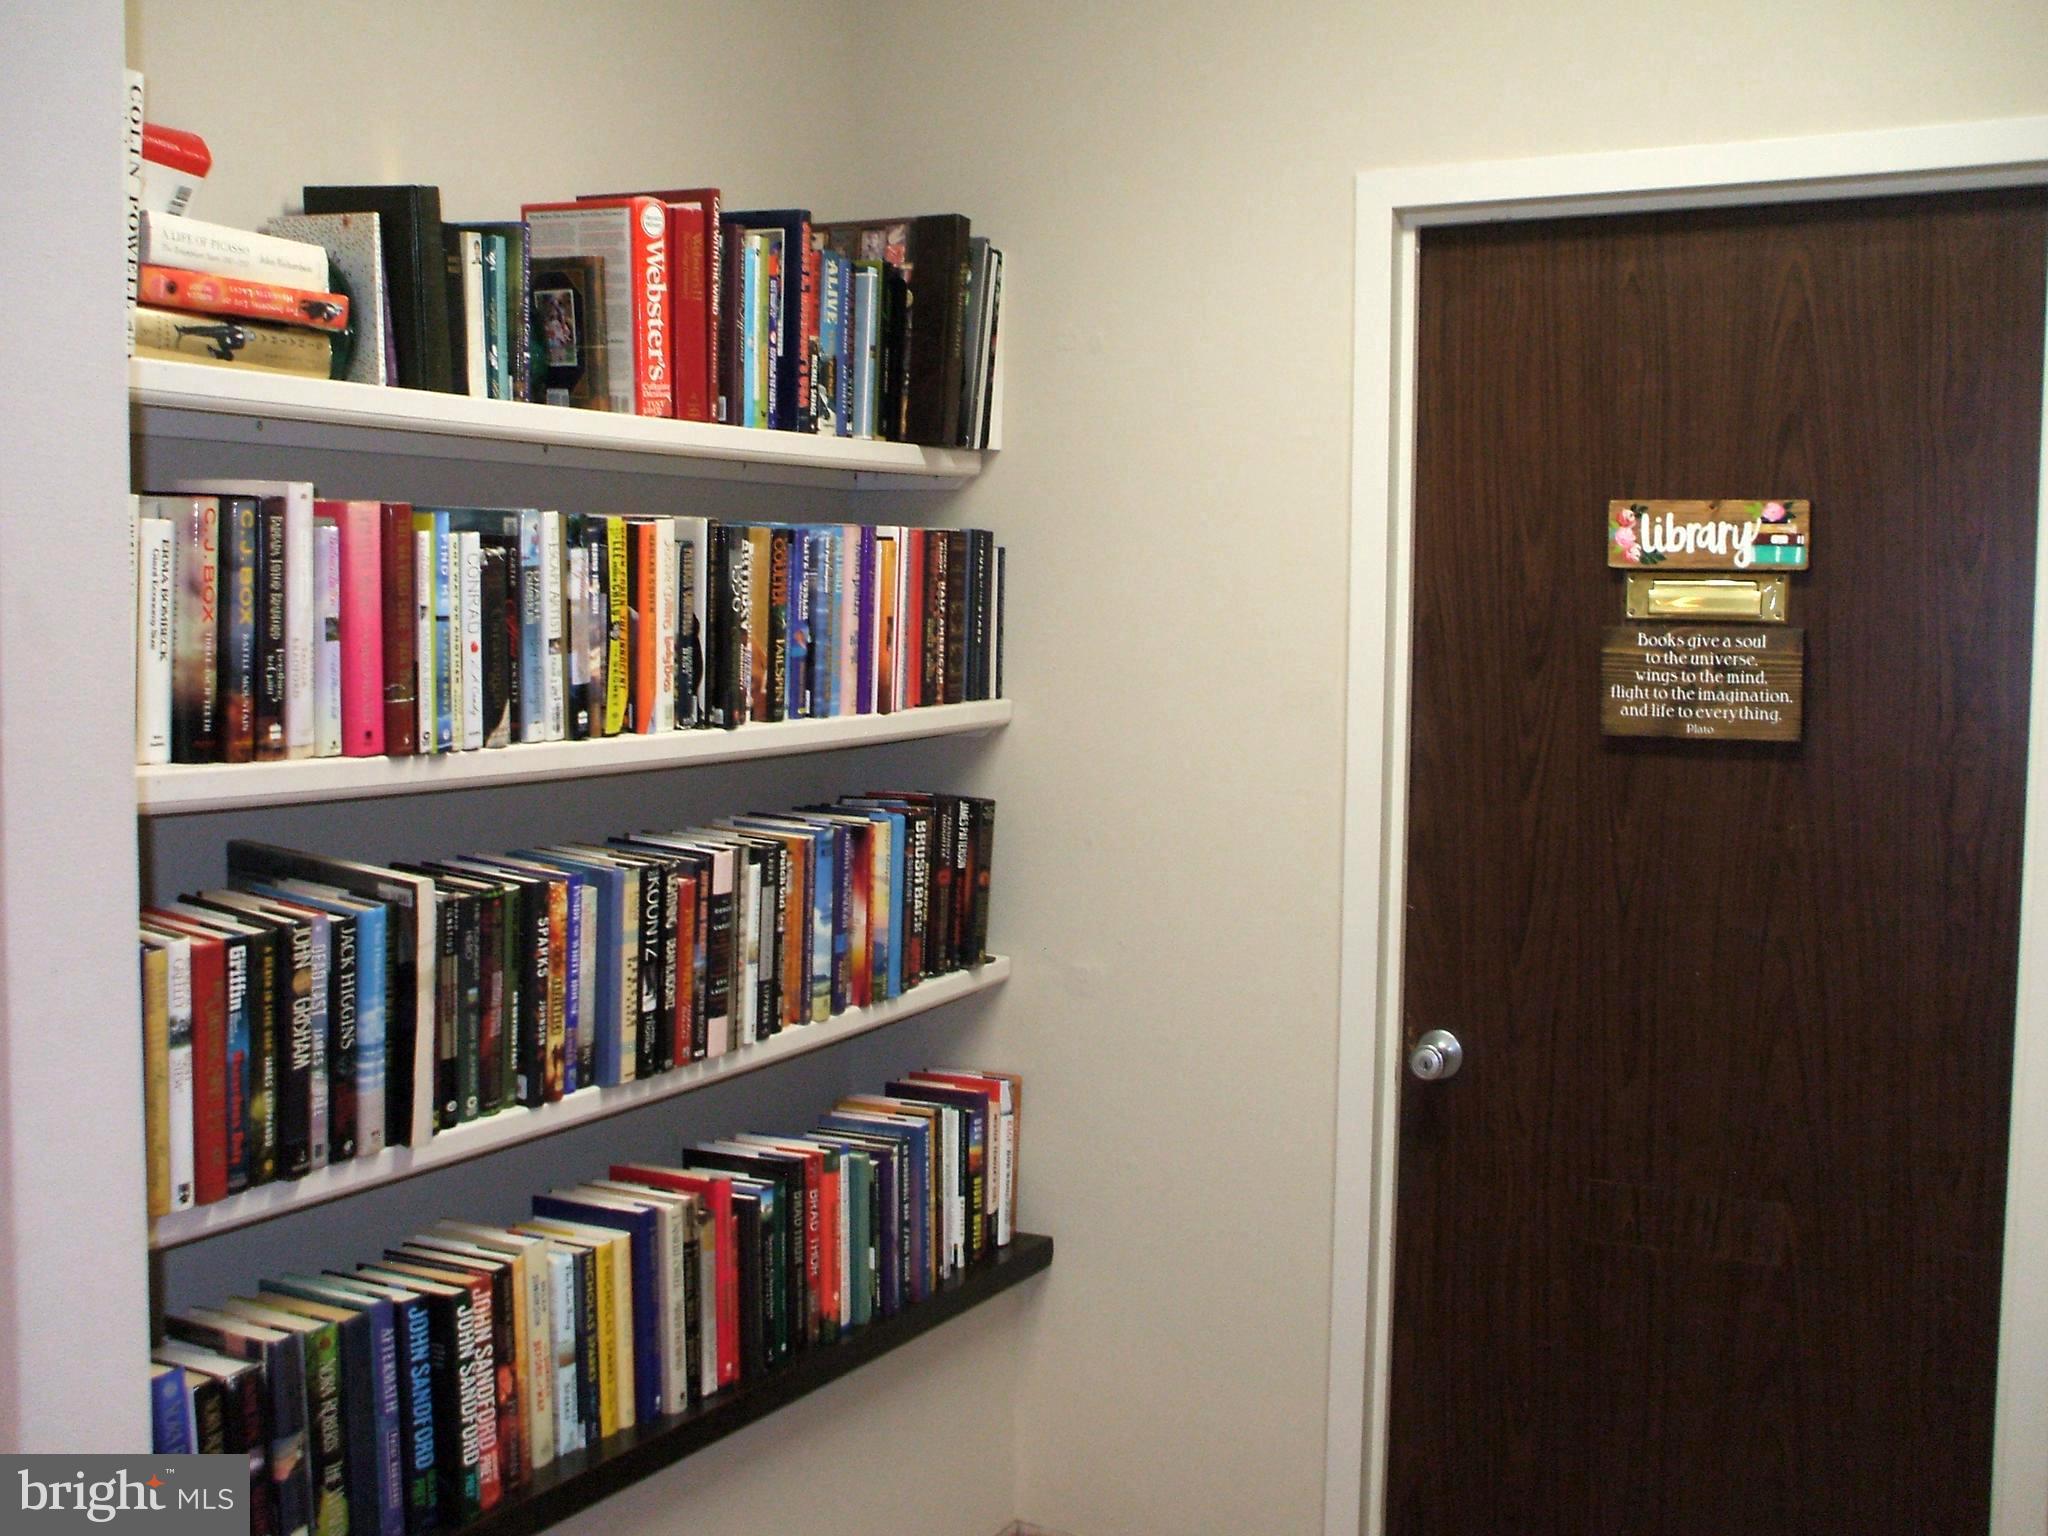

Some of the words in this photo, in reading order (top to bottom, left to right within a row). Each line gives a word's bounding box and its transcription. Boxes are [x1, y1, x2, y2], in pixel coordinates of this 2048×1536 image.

[711, 230, 719, 260] WITH
[711, 262, 719, 282] THE
[826, 260, 838, 325] ALIVE
[645, 238, 667, 382] Webster's
[711, 282, 719, 316] WIND
[810, 354, 818, 386] MICHAEL
[810, 389, 818, 416] SAVAGE
[270, 516, 284, 556] BARBARA
[441, 533, 449, 576] FIND
[1641, 512, 1761, 568] library
[160, 539, 170, 583] ERMA
[270, 559, 283, 591] TAYLOR
[202, 565, 214, 624] BOX
[239, 566, 253, 625] BOX
[270, 593, 284, 640] BRADFORD
[441, 583, 449, 608] ME
[466, 553, 479, 634] CONRAD
[549, 591, 560, 634] ARTIST
[802, 572, 810, 620] CUSSLER
[160, 588, 170, 662] BOMBECK
[1638, 632, 1684, 648] Books
[1687, 635, 1719, 650] give
[1722, 639, 1731, 648] a
[1735, 634, 1766, 649] soul
[775, 637, 785, 703] TAILSPIN
[1636, 668, 1678, 685] wings
[1681, 670, 1696, 682] to
[1700, 669, 1725, 683] the
[1645, 652, 1661, 663] to
[1664, 651, 1687, 664] the
[1611, 685, 1650, 700] flight
[1653, 688, 1668, 699] to
[1671, 687, 1695, 700] the
[1620, 704, 1649, 717] and
[1651, 704, 1675, 718] life
[1678, 705, 1693, 718] to
[1686, 724, 1714, 734] Plato
[959, 801, 969, 826] JAMES
[914, 820, 926, 884] BRUSH
[957, 827, 968, 868] PATTERSON
[644, 877, 660, 962] KOONTZ
[666, 872, 677, 929] LIGHTNING
[914, 887, 924, 933] BACK
[293, 926, 311, 970] JOHN
[340, 926, 355, 970] JACK
[537, 917, 548, 978] SPARKS
[228, 944, 246, 1011] Griffin
[312, 985, 326, 1016] LAST
[292, 997, 310, 1070] GRISHAM
[340, 973, 355, 1049] HIGGINS
[538, 1000, 546, 1046] JOHNSON
[810, 1188, 818, 1232] BRAD
[810, 1238, 818, 1276] THOR
[472, 1288, 492, 1342] JOHN
[585, 1255, 595, 1330] NICHOLAS
[408, 1307, 429, 1360] JOHN
[457, 1305, 477, 1359] JOHN
[319, 1359, 337, 1398] NORA
[381, 1328, 397, 1413] AFTERMATH
[412, 1363, 434, 1469] SANDFORD
[459, 1364, 478, 1466] SANDFORD
[476, 1346, 496, 1451] SANDFORD
[318, 1397, 338, 1452] ROBERTS
